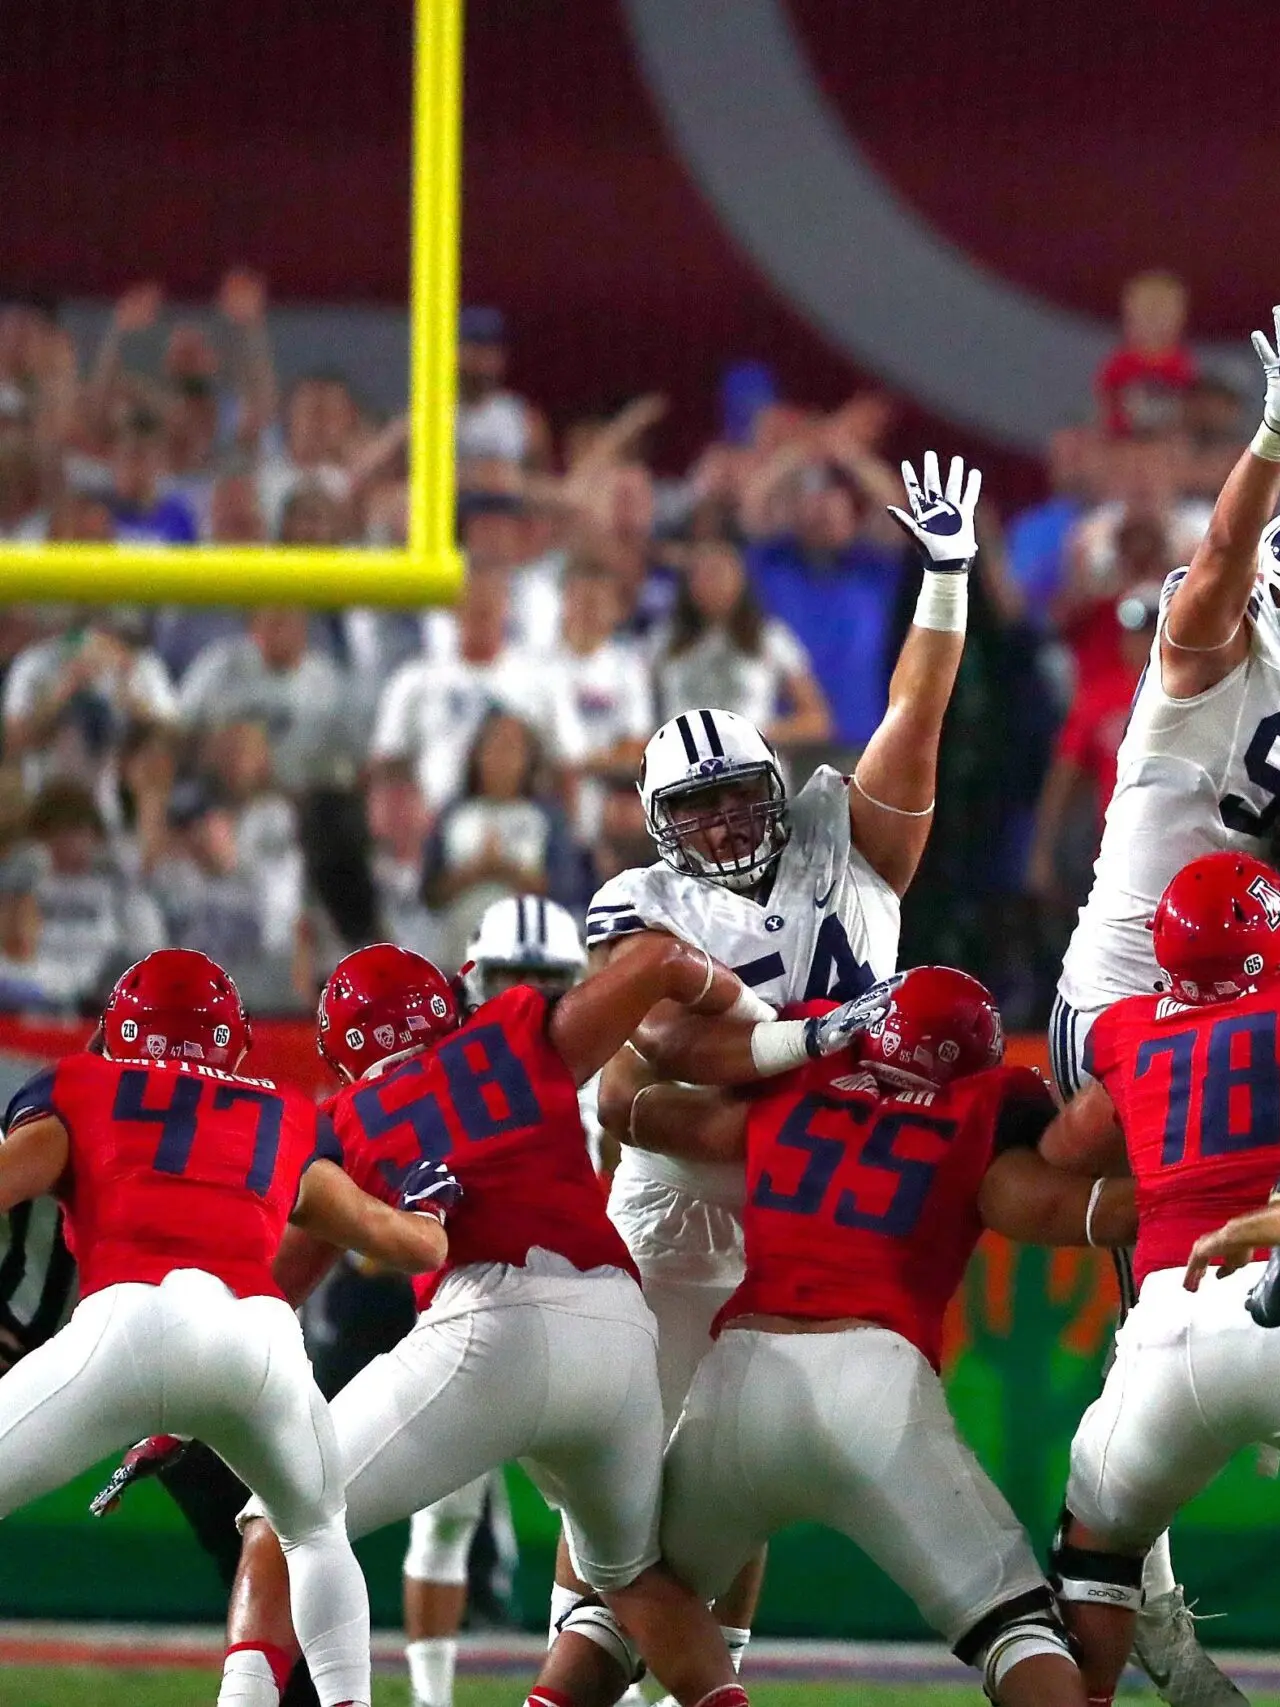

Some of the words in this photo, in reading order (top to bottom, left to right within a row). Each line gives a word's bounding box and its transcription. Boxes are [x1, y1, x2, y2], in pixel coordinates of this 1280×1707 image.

[1246, 956, 1261, 974] 65
[432, 998, 445, 1017] 65
[123, 1023, 136, 1039] ZH
[215, 1027, 228, 1044] 65
[170, 1046, 182, 1057] 47
[352, 1022, 543, 1190] 58
[112, 1070, 285, 1197] 47
[751, 1092, 957, 1235] 55
